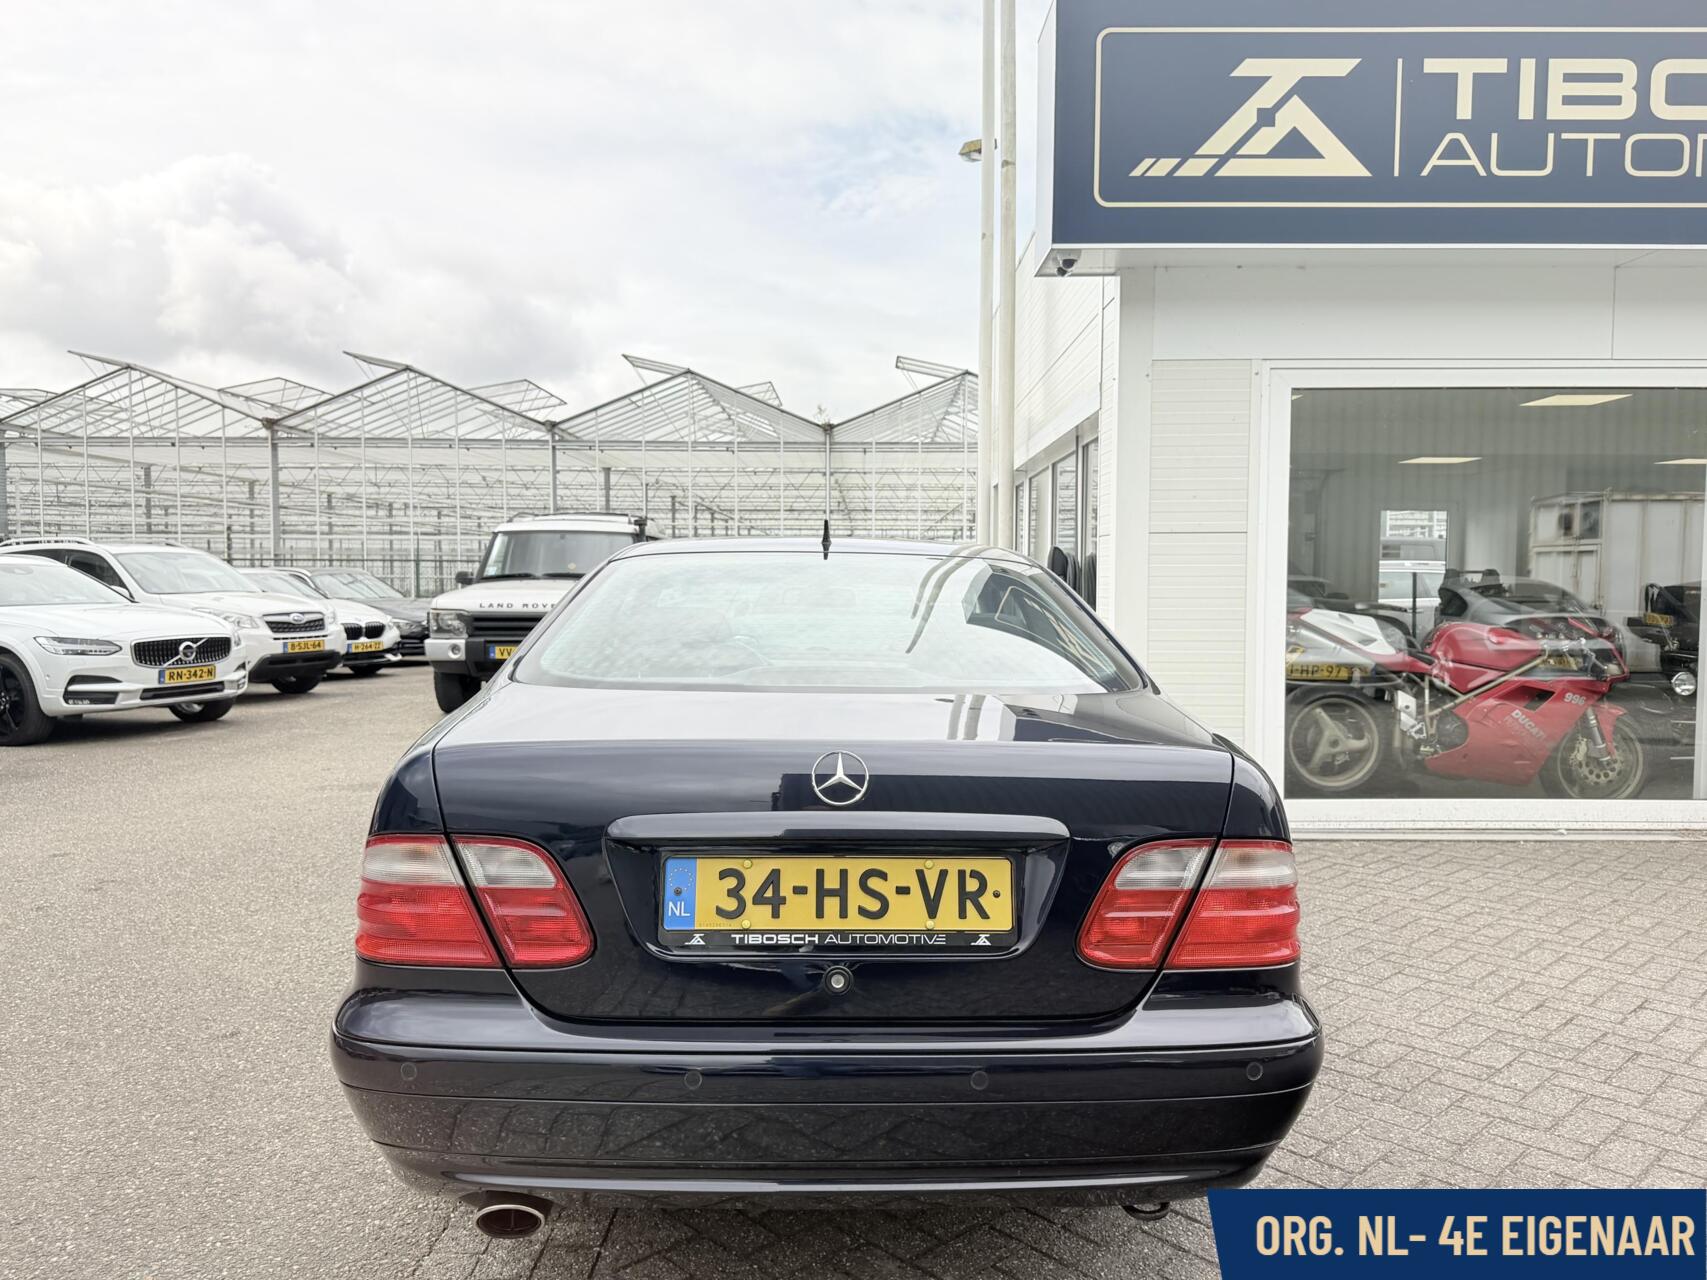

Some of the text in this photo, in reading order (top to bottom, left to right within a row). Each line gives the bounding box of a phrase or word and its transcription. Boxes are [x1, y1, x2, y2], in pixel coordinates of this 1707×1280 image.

[1420, 133, 1707, 177] AUTO
[168, 667, 214, 681] RN-342-N
[1563, 692, 1587, 705] 996
[715, 867, 991, 919] 34-HS-VR
[668, 901, 690, 917] NL
[731, 933, 947, 945] TIBOSCH AUTOMOTIVE
